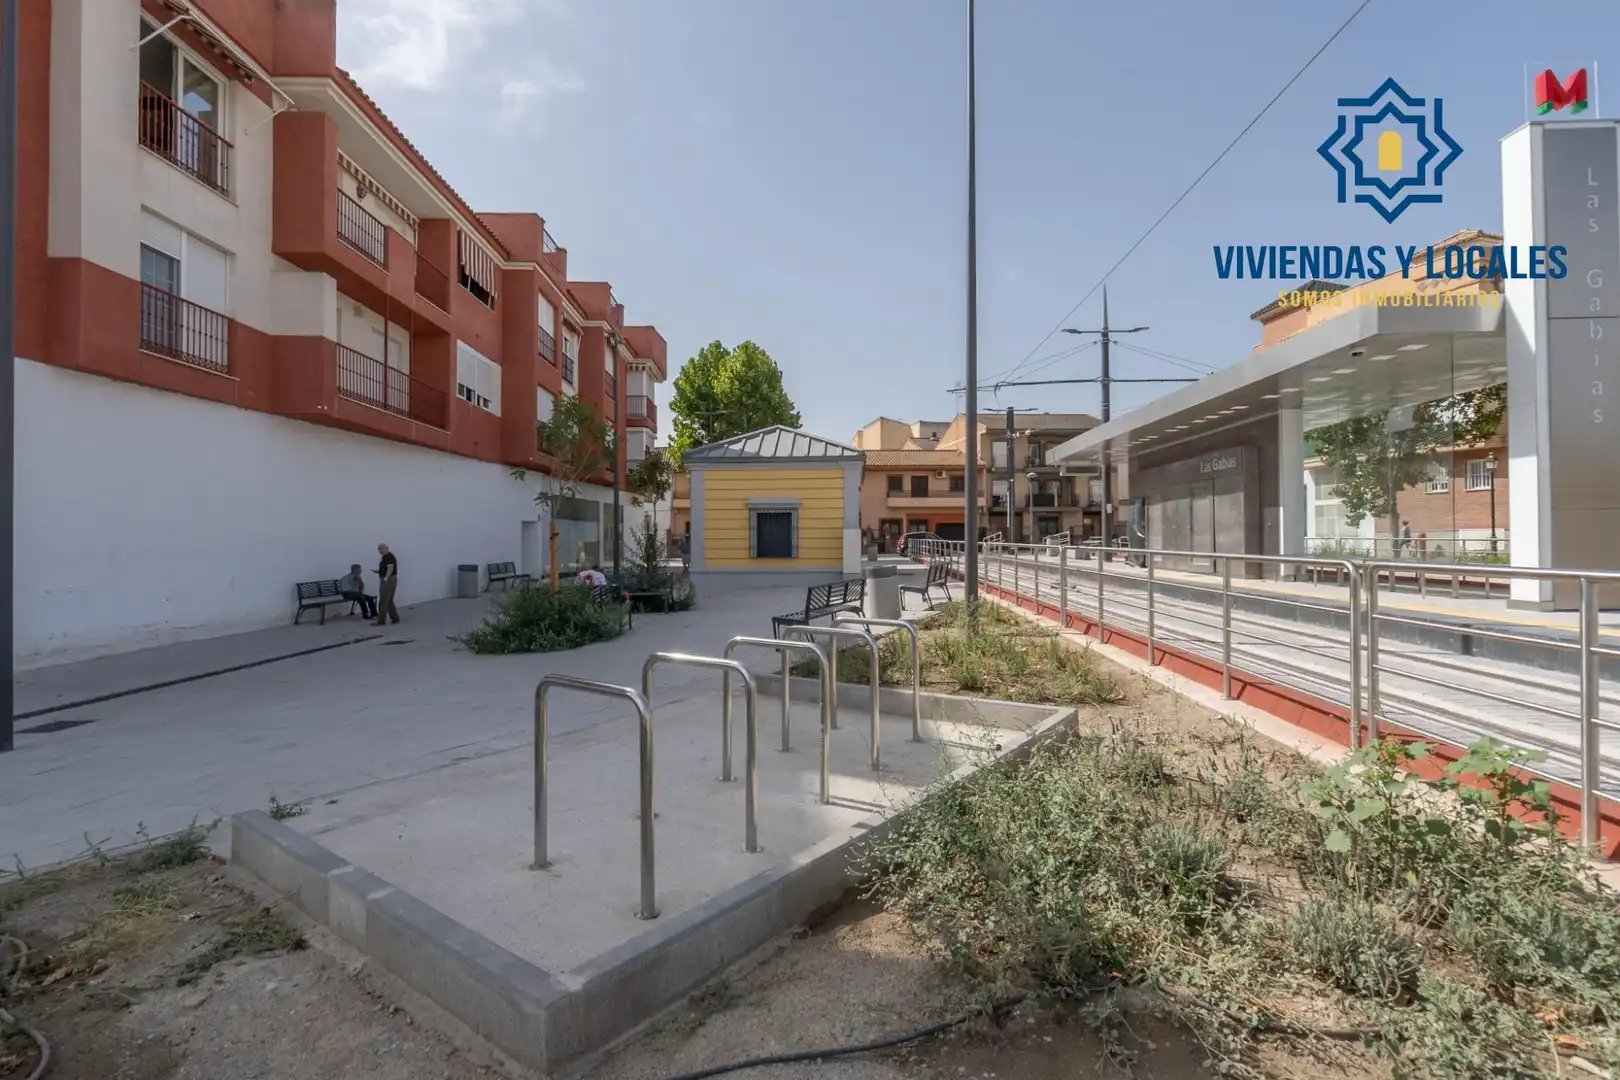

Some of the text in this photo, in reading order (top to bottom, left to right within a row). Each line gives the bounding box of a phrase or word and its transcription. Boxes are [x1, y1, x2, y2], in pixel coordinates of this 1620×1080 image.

[1534, 68, 1588, 115] M
[1586, 166, 1604, 424] Las Gabias
[1200, 456, 1236, 474] Las Gabias
